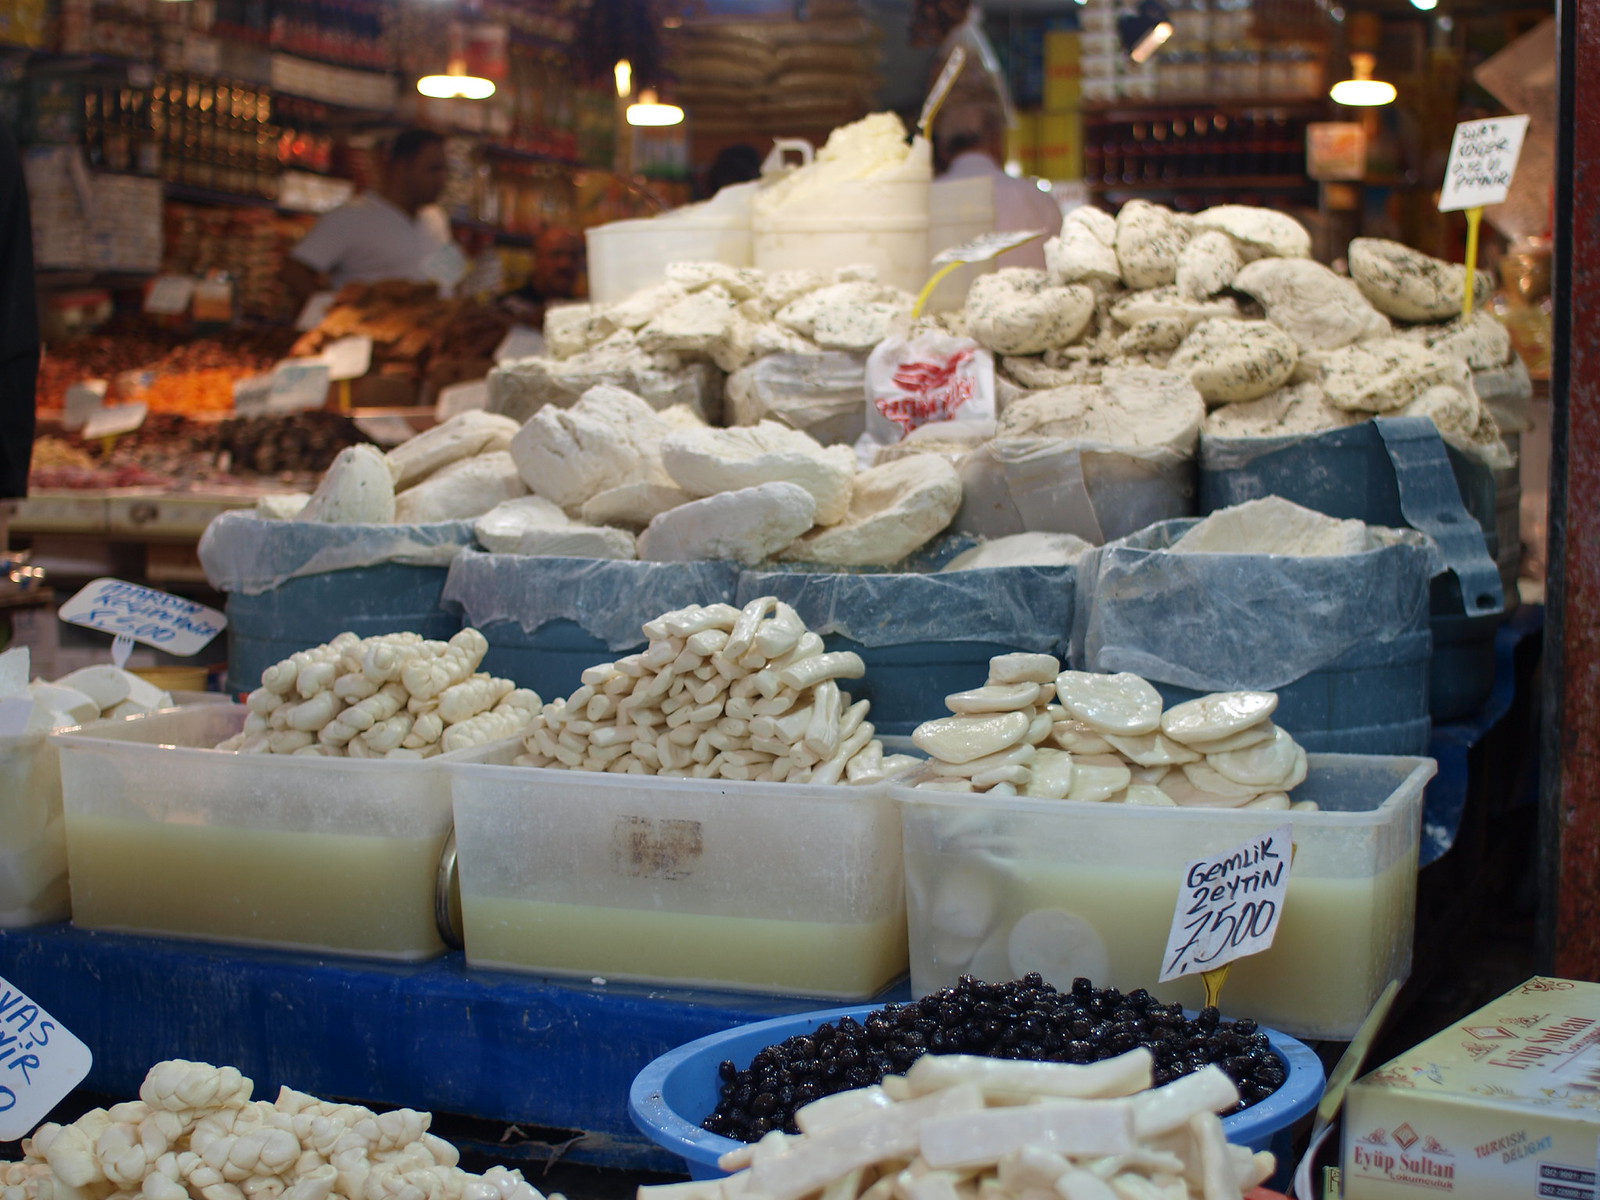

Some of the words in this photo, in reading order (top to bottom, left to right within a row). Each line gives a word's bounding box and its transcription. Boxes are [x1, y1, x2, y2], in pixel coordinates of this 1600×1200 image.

[1354, 1145, 1395, 1175] Eyüp
[1399, 1153, 1455, 1180] Sultan
[1502, 1135, 1553, 1165] DELIGHT
